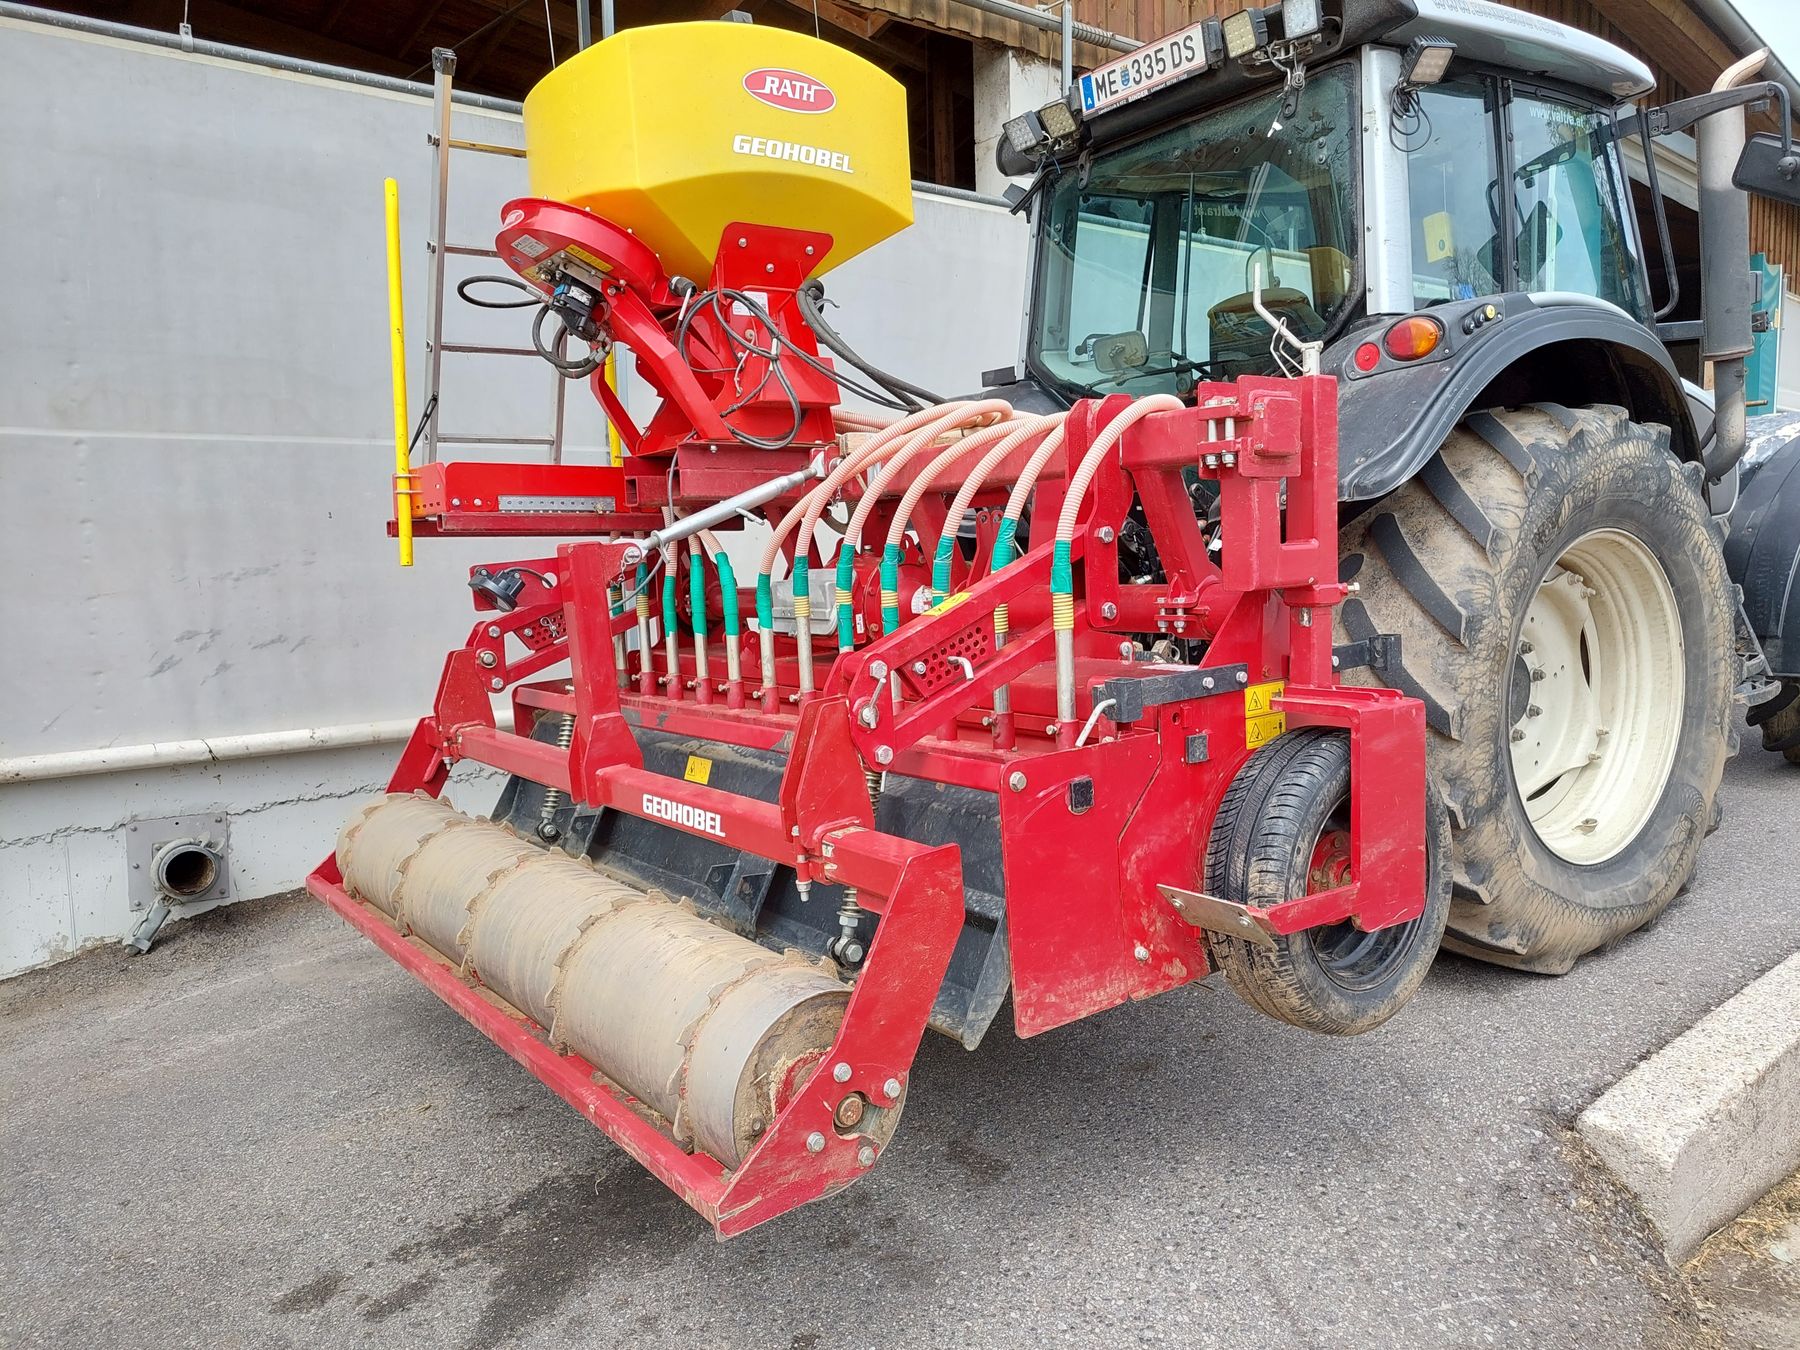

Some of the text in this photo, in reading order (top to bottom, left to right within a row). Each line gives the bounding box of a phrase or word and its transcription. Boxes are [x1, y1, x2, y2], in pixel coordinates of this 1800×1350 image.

[1094, 69, 1119, 102] ME
[1131, 47, 1167, 86] 335
[1169, 34, 1196, 69] DS
[760, 75, 820, 103] RATH
[1087, 97, 1093, 106] A
[1529, 106, 1584, 128] www.valtra.at
[732, 134, 854, 174] GEOHOBEL
[642, 793, 726, 838] GEOHOBEL
